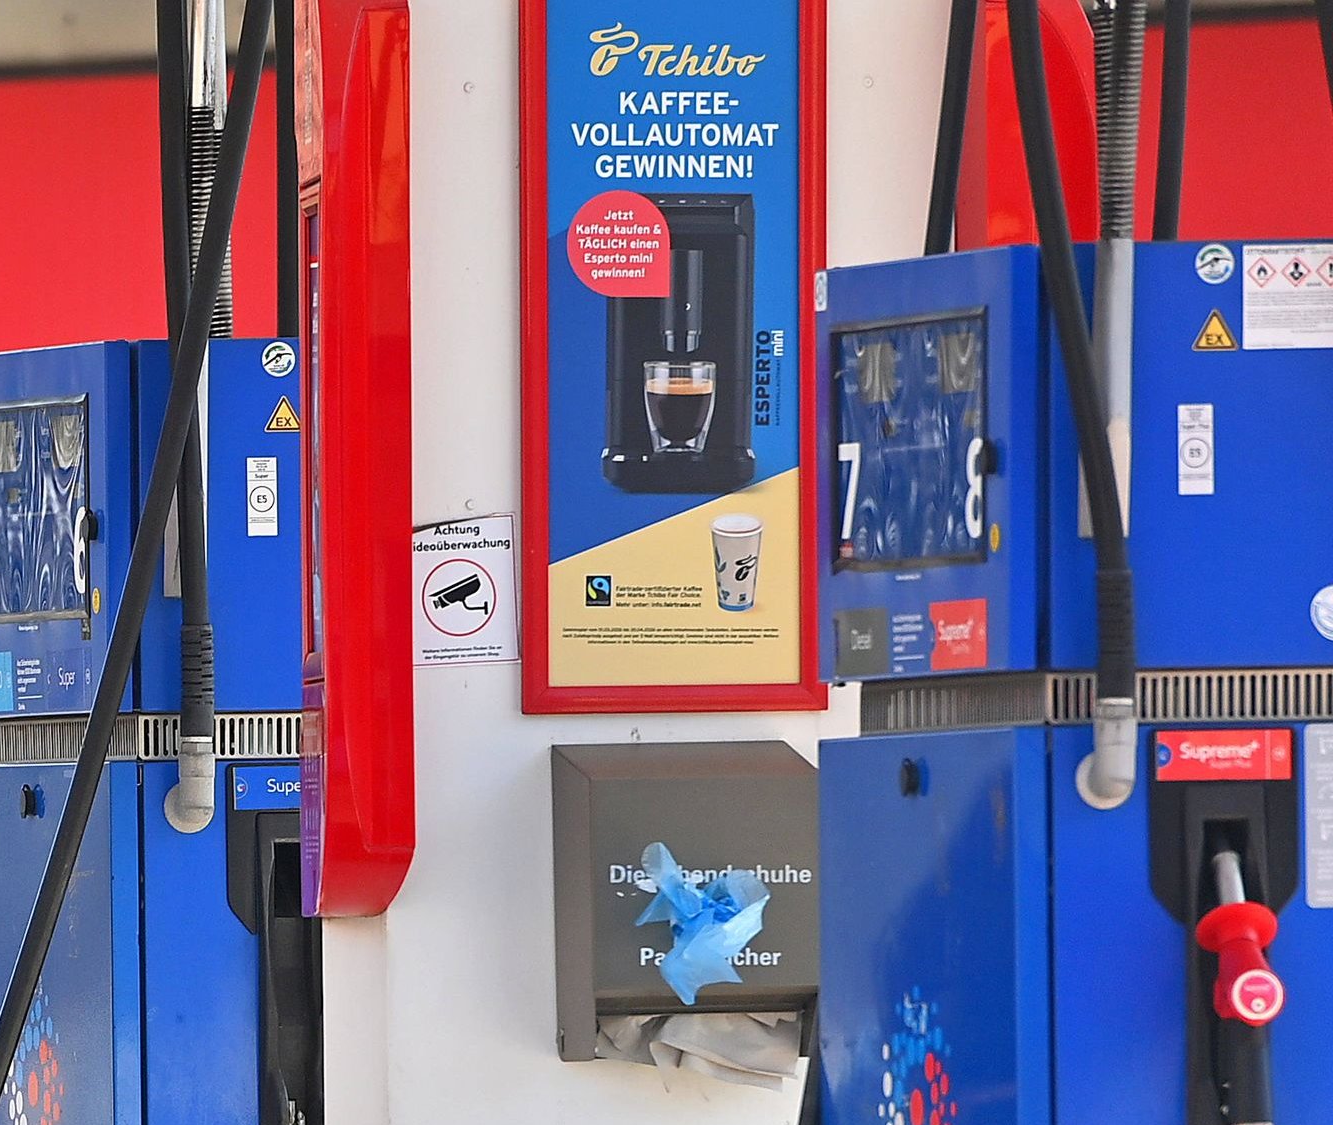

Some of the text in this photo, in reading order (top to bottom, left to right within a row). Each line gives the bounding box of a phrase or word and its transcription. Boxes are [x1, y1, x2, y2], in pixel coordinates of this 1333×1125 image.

[638, 44, 766, 77] Tchibo
[619, 91, 739, 115] KAFFEE-
[571, 123, 779, 147] VOLLAUTOMAT
[595, 154, 753, 178] GEWINNEN!
[603, 210, 634, 220] Jetzt
[576, 224, 662, 235] Kaffee kaufen &
[578, 236, 660, 249] TÄGLICH einen
[584, 252, 653, 265] Esperto mini
[591, 267, 646, 279] gewinnen!
[771, 330, 784, 357] mini
[1205, 334, 1224, 346] EX
[755, 330, 771, 426] ESPERTO
[275, 416, 293, 427] EX
[838, 437, 983, 540] 7 8
[257, 494, 268, 504] E5
[434, 525, 480, 536] Achtung
[73, 506, 86, 593] 6
[413, 538, 511, 552] ideoüberwachung
[58, 667, 76, 691] Super
[266, 778, 301, 796] Supe
